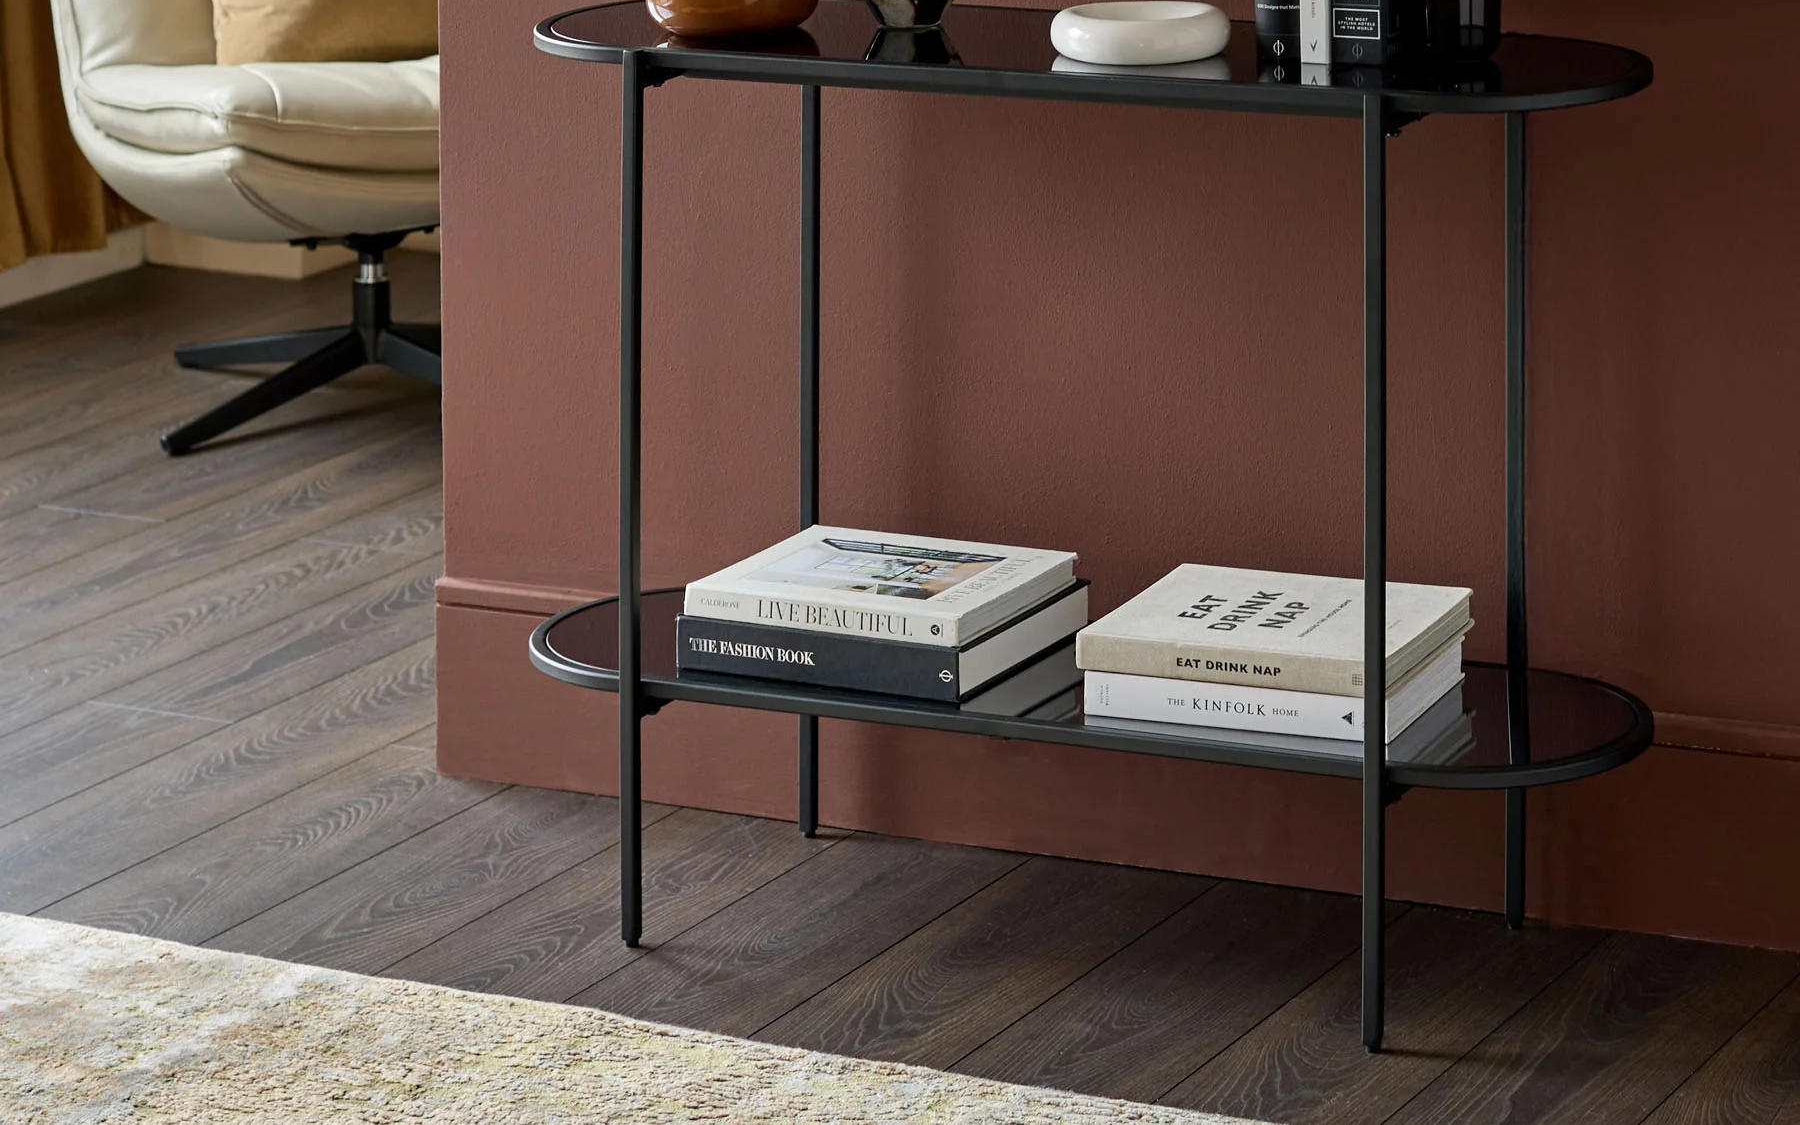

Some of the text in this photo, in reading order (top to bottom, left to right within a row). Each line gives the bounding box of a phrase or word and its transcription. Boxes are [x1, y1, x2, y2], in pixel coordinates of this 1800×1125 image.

[700, 597, 740, 610] CALDERONE
[1177, 595, 1228, 619] EAT
[1206, 590, 1284, 631] DRINK
[1257, 601, 1310, 629] NAP
[756, 599, 801, 622] LIVE
[805, 604, 913, 637] BEAUTIFUL
[688, 637, 815, 666] THE FASHION BOOK
[1176, 657, 1282, 677] EAT DRINK NAP
[1167, 697, 1299, 717] THE KINFOLK HOME
